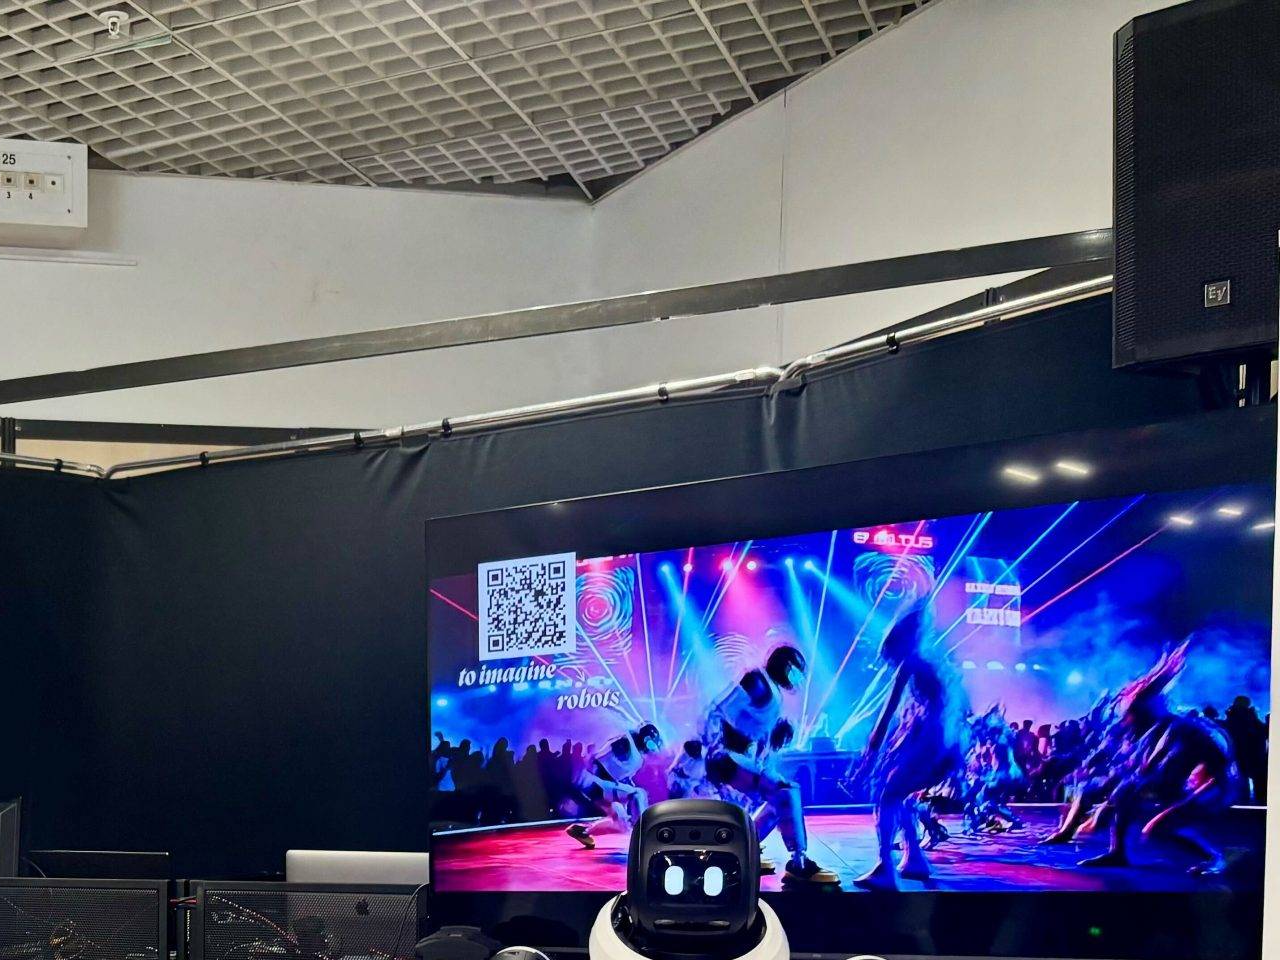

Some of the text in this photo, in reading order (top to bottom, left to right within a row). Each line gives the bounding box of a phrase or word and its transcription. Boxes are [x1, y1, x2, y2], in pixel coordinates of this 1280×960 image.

[2, 153, 16, 165] 25
[458, 661, 558, 687] to imagine
[557, 688, 621, 711] robots
